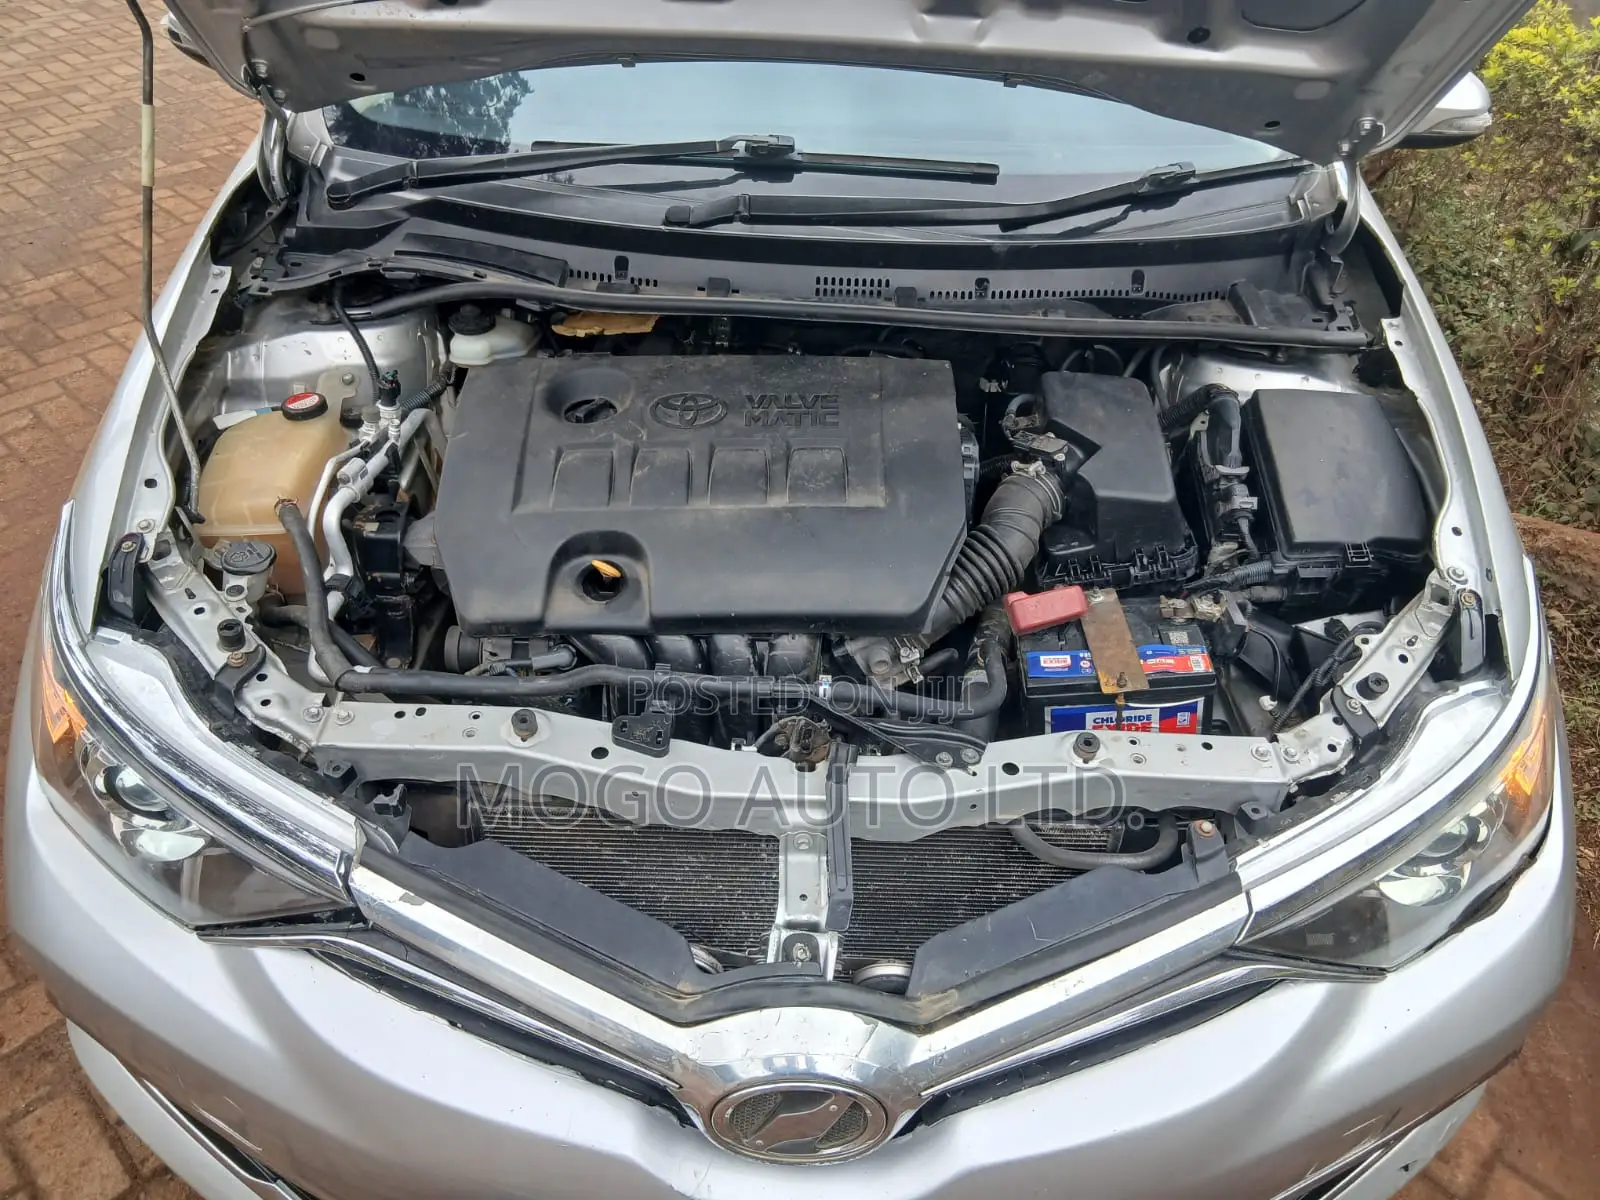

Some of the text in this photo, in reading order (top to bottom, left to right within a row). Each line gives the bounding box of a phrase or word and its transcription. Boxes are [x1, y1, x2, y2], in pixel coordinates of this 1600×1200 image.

[744, 394, 839, 409] VALVE
[743, 411, 839, 427] MATIC
[1093, 714, 1153, 724] CHLRIDE
